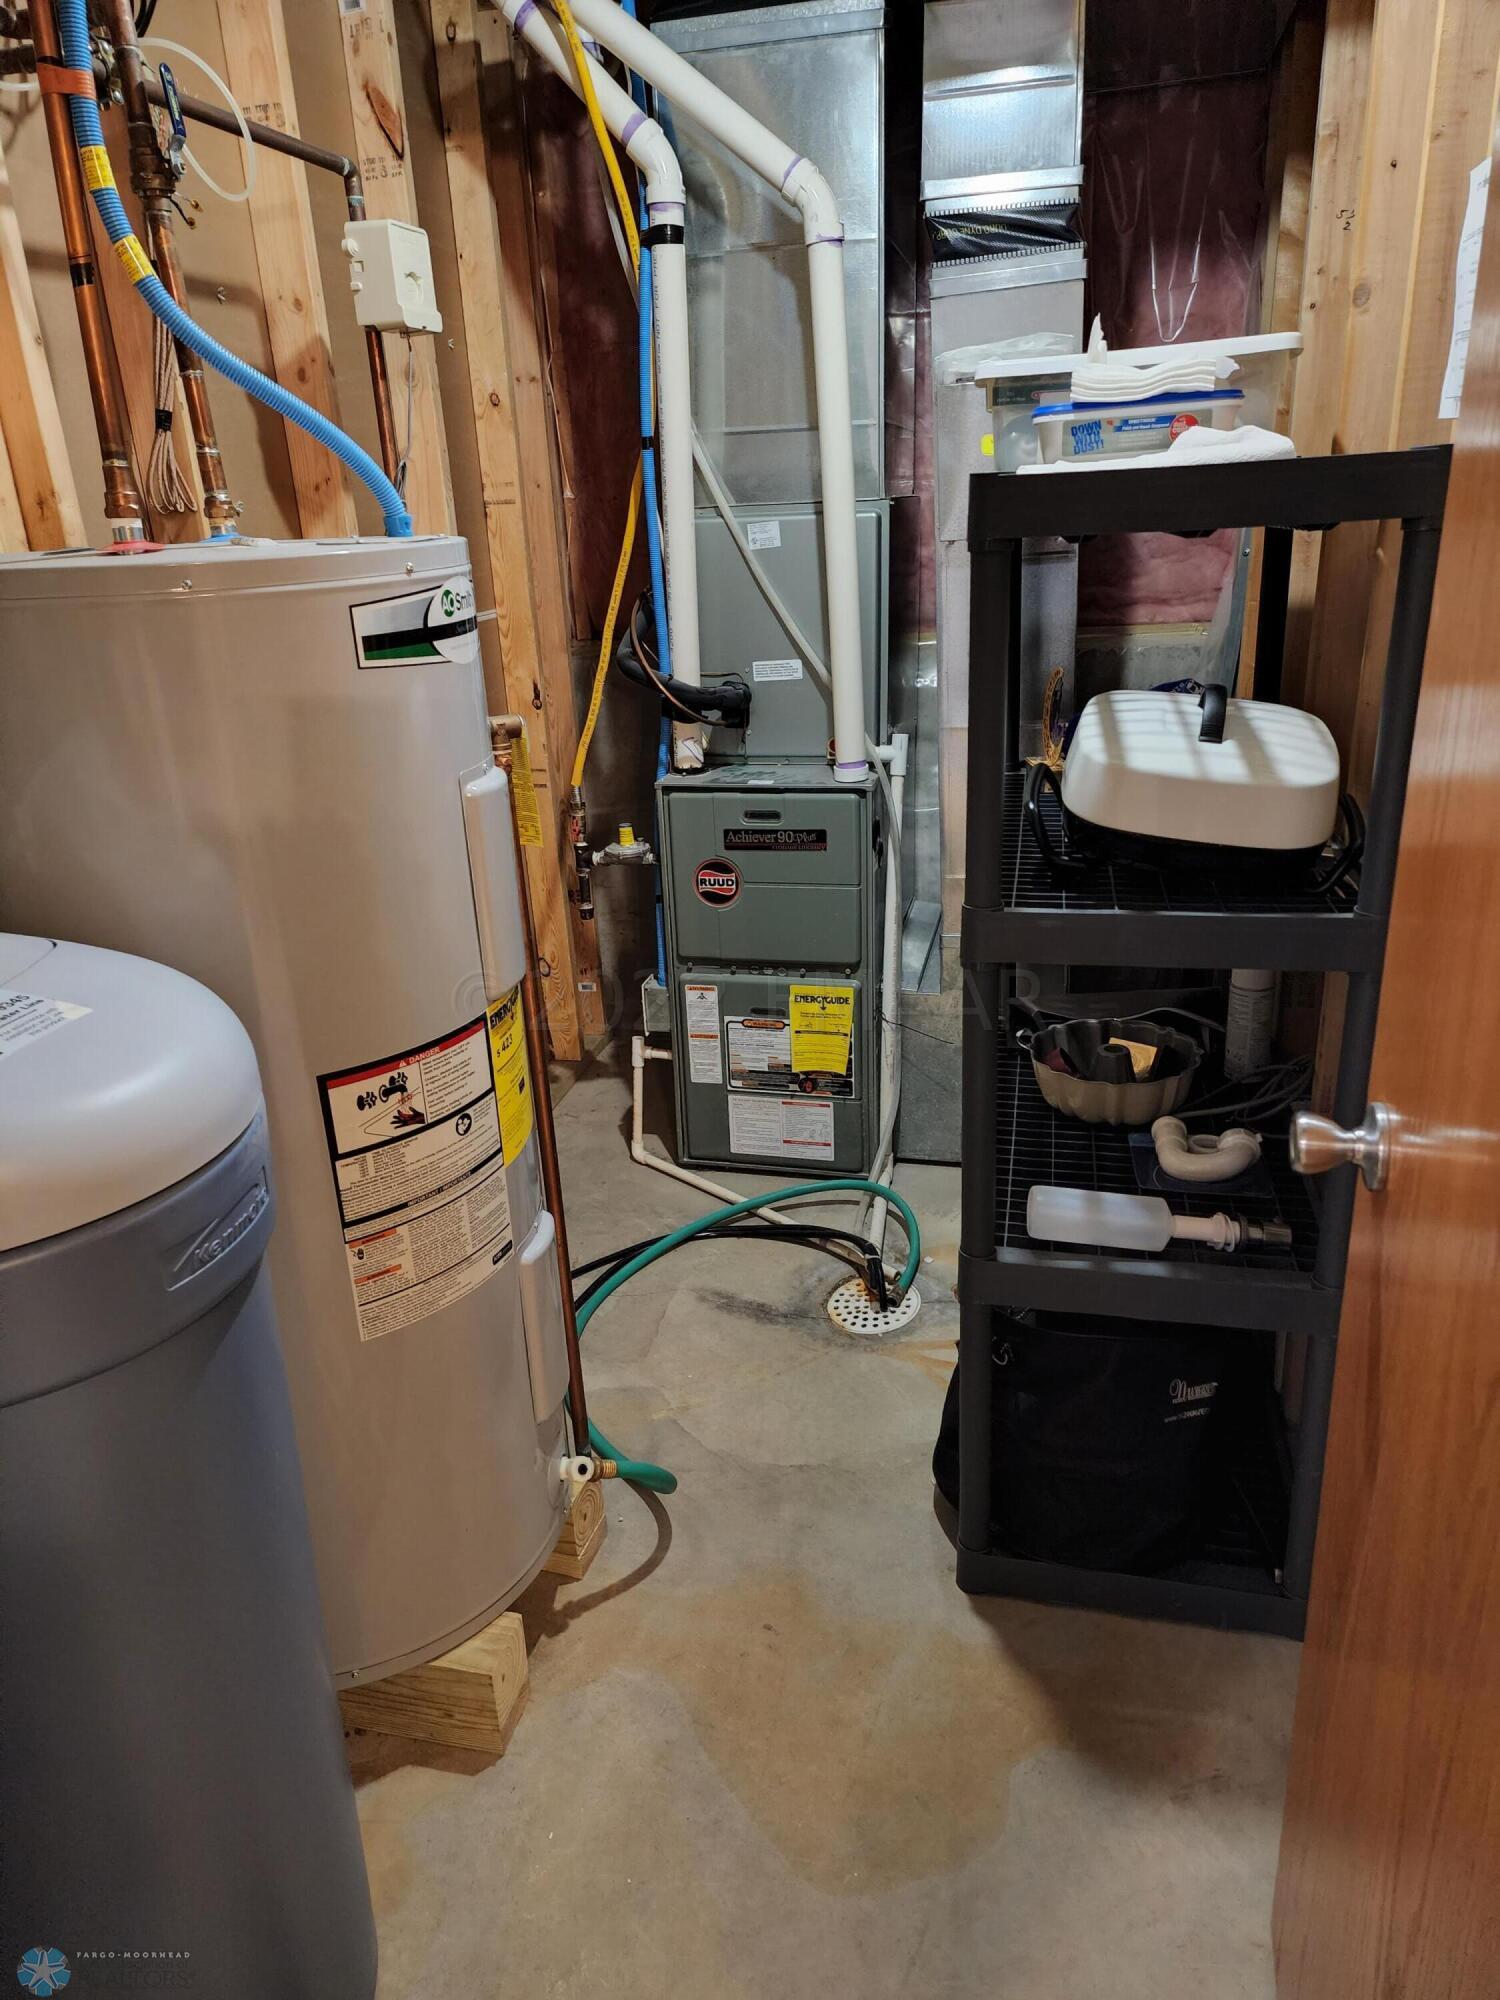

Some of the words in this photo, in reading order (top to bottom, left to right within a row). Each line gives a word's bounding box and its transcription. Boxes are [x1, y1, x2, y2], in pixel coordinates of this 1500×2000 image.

[1071, 419, 1102, 437] DOWN
[1073, 439, 1105, 455] DUST!
[726, 830, 777, 843] Achiever
[777, 831, 793, 843] 90
[699, 877, 735, 887] RUUD
[794, 994, 851, 1006] ENERGYGUIDE
[409, 1046, 441, 1064] DANGER
